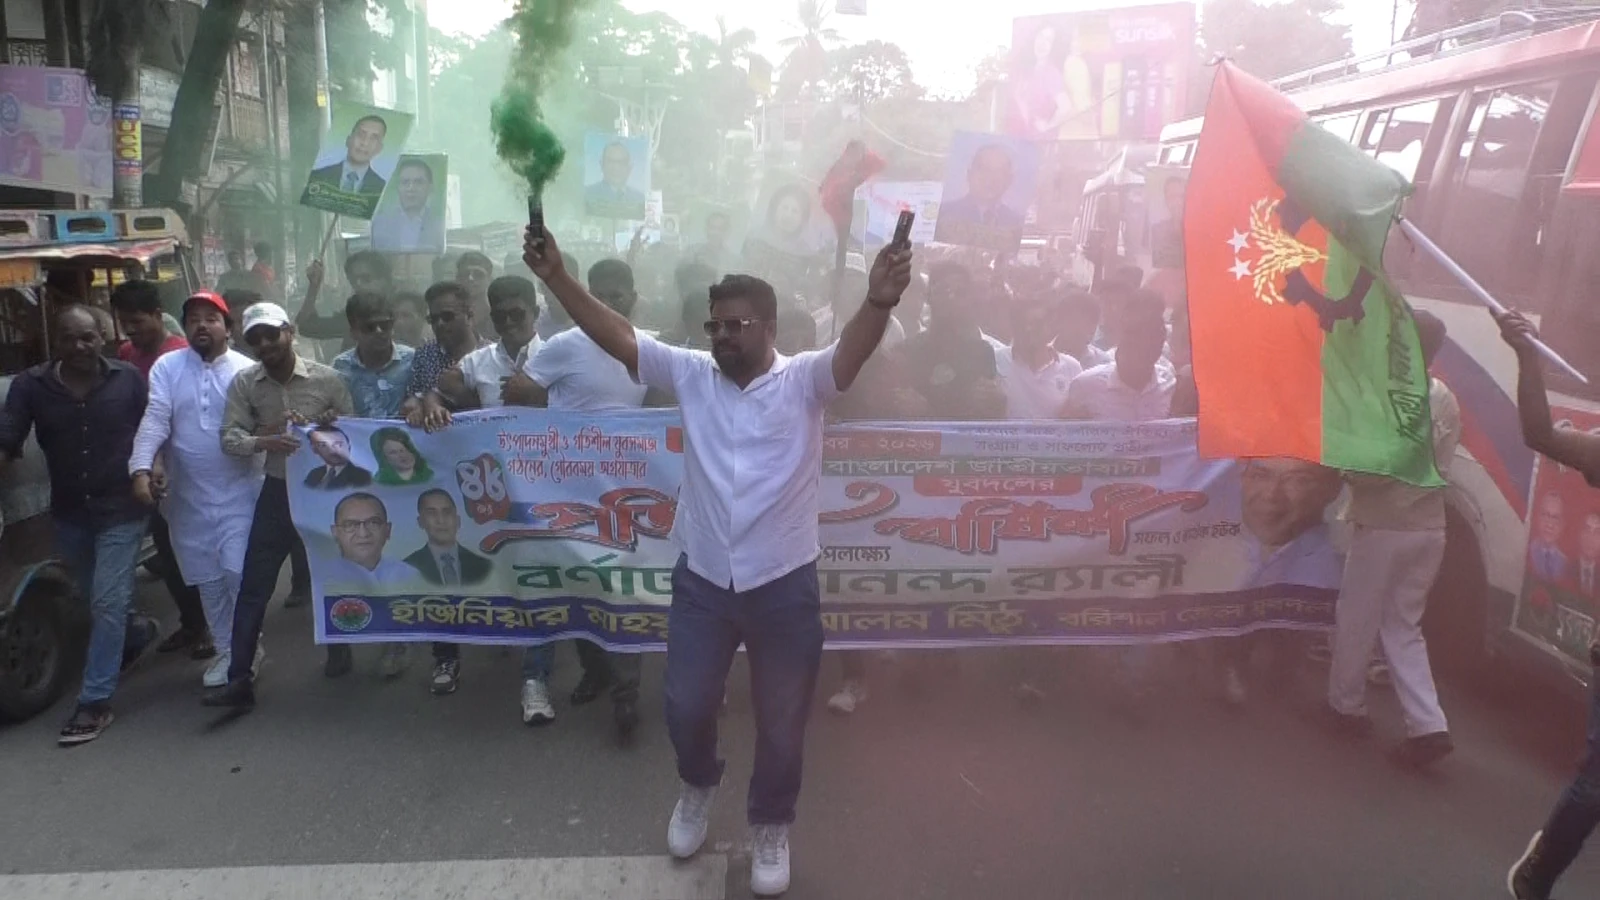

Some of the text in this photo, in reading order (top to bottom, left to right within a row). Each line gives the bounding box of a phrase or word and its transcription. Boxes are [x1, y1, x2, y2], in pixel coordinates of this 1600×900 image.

[1115, 22, 1176, 44] suns
[497, 423, 560, 459] উৎপাদনমুখী
[562, 435, 570, 451] ও
[573, 425, 611, 455] গতিশীল
[826, 456, 1148, 477] বাংলাদেশ জাতীয়তাবাদী
[941, 477, 1055, 496] যুবদলের
[512, 552, 672, 597] বর্ণাঢ
[390, 596, 571, 630] ইঞ্জিনিয়ার
